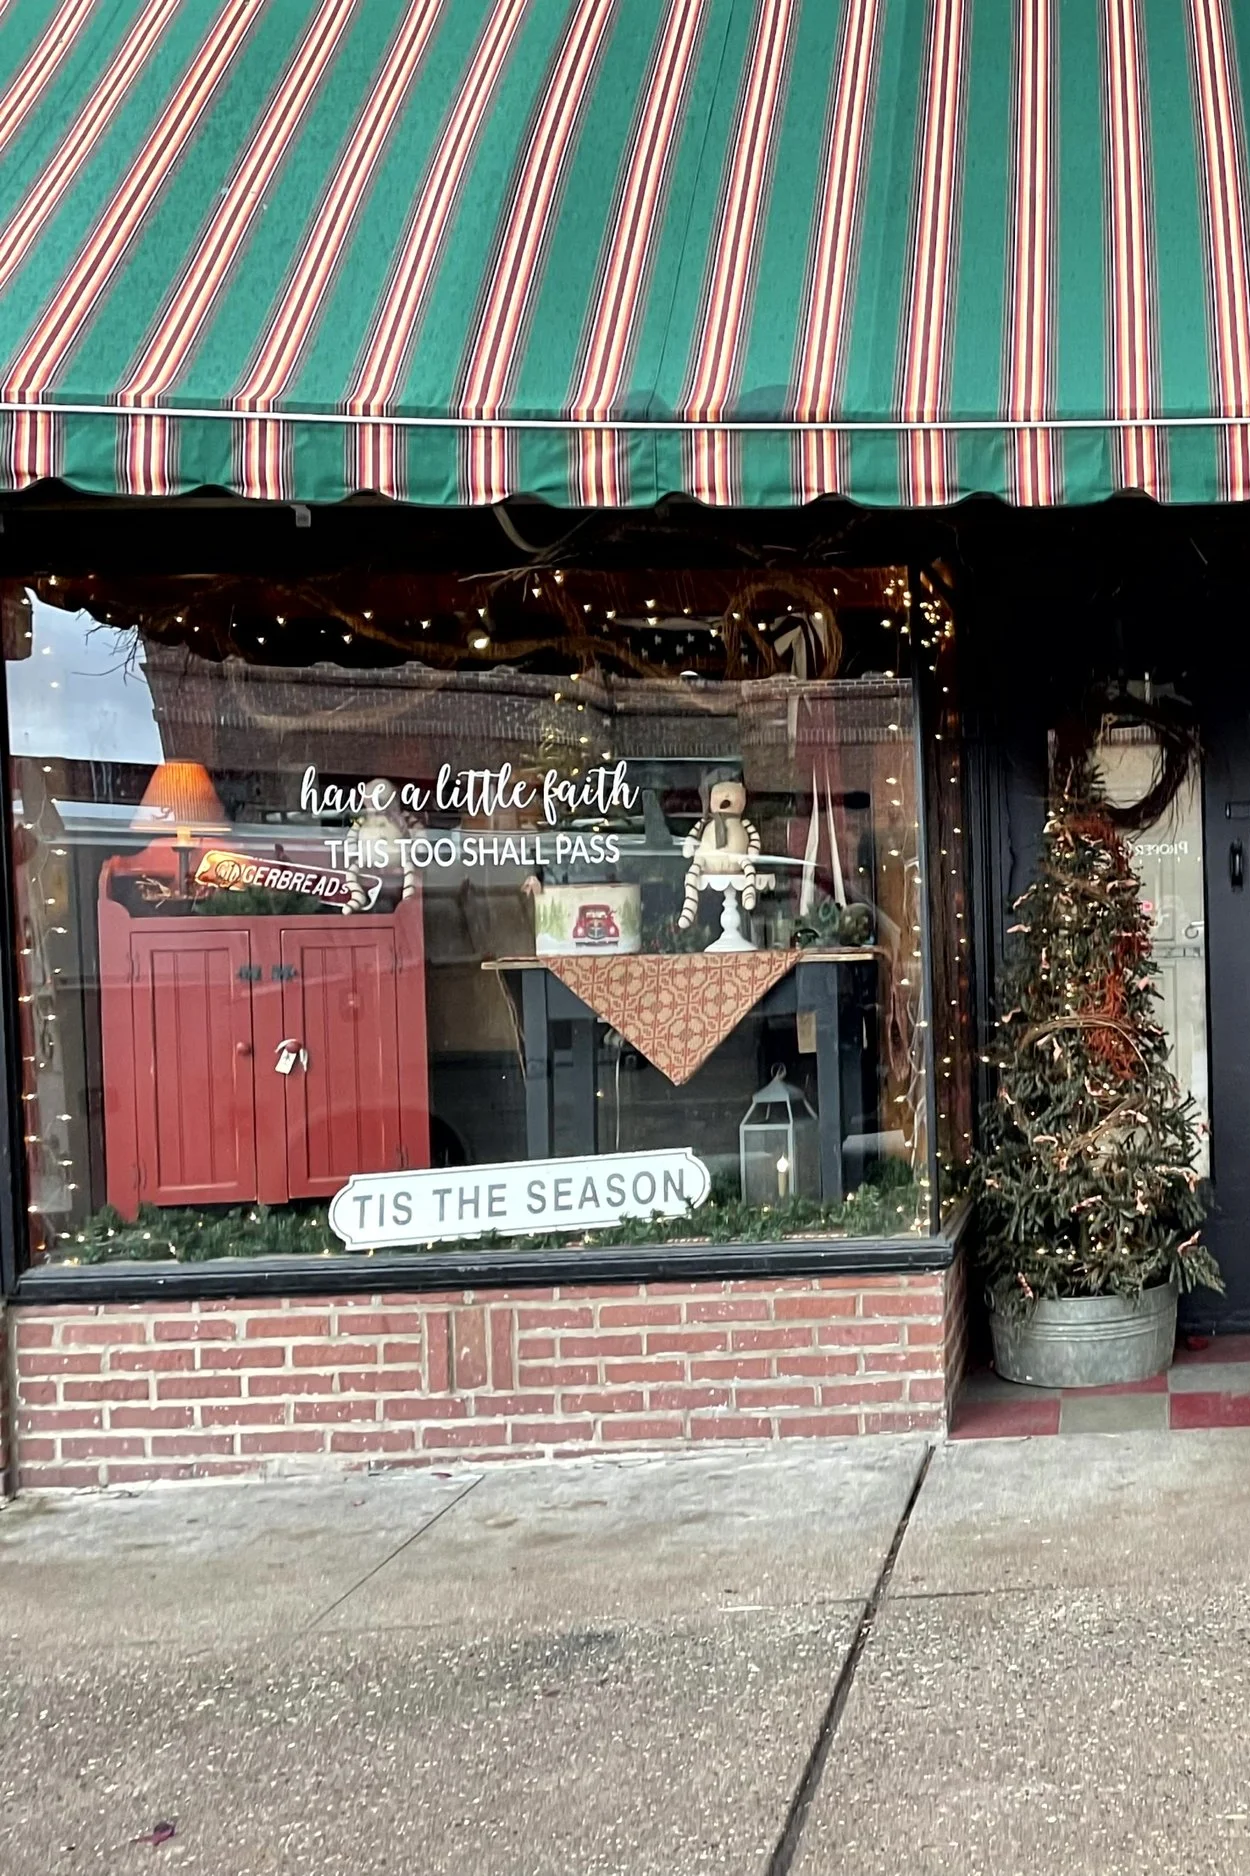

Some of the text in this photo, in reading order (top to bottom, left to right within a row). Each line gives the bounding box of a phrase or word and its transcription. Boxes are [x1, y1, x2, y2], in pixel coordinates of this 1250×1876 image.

[301, 760, 640, 826] have a little faith
[324, 834, 620, 869] THIS TOO SHALL PASS
[352, 1168, 685, 1229] TIS THE SEASON
